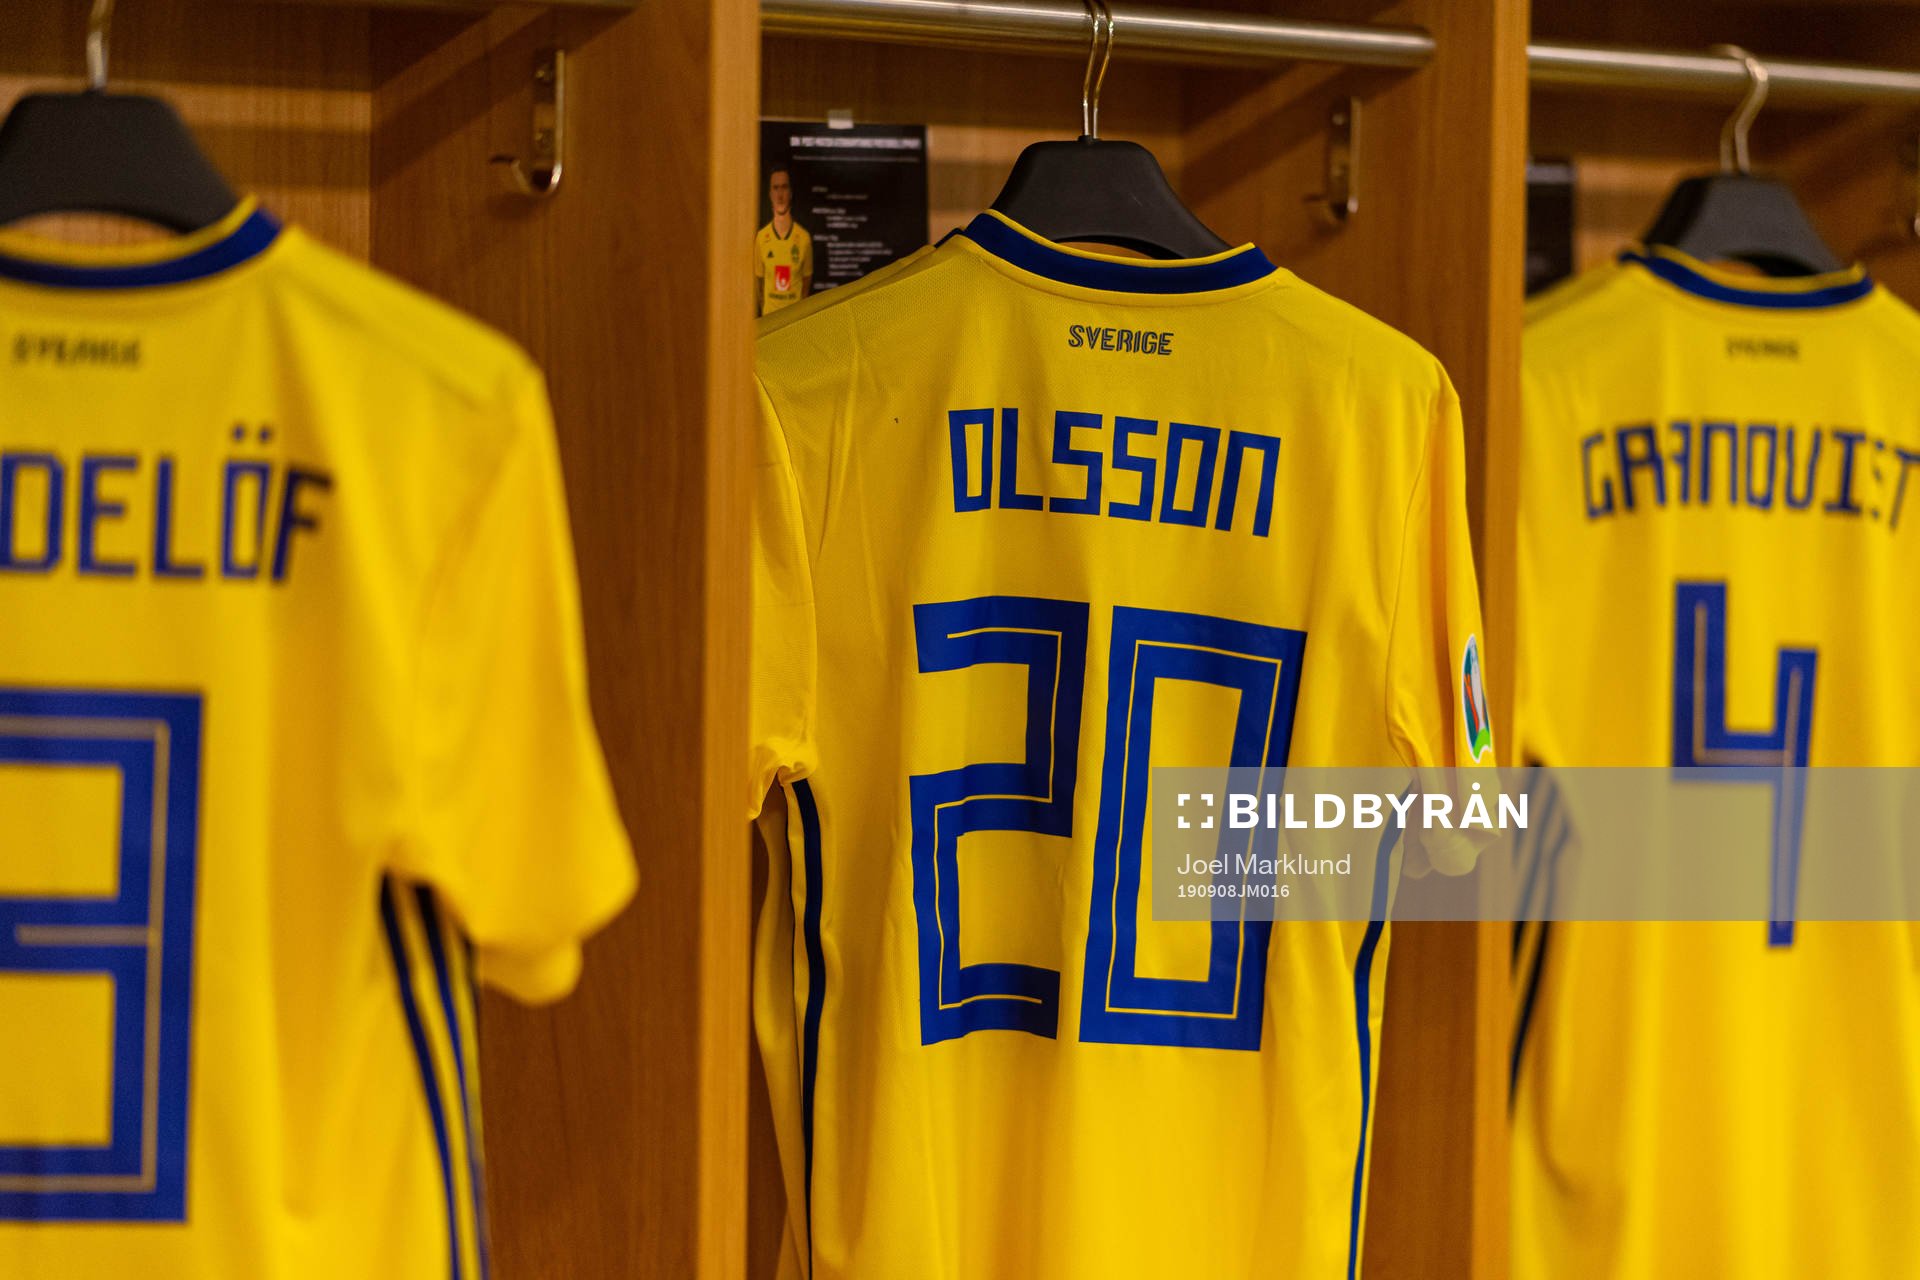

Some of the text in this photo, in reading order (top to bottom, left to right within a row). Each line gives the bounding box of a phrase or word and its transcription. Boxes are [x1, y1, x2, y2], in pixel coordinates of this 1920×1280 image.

[1068, 325, 1174, 355] SVERIGE
[948, 408, 1281, 537] OLSSON
[909, 596, 1308, 1051] 20
[1671, 580, 1818, 948] 4
